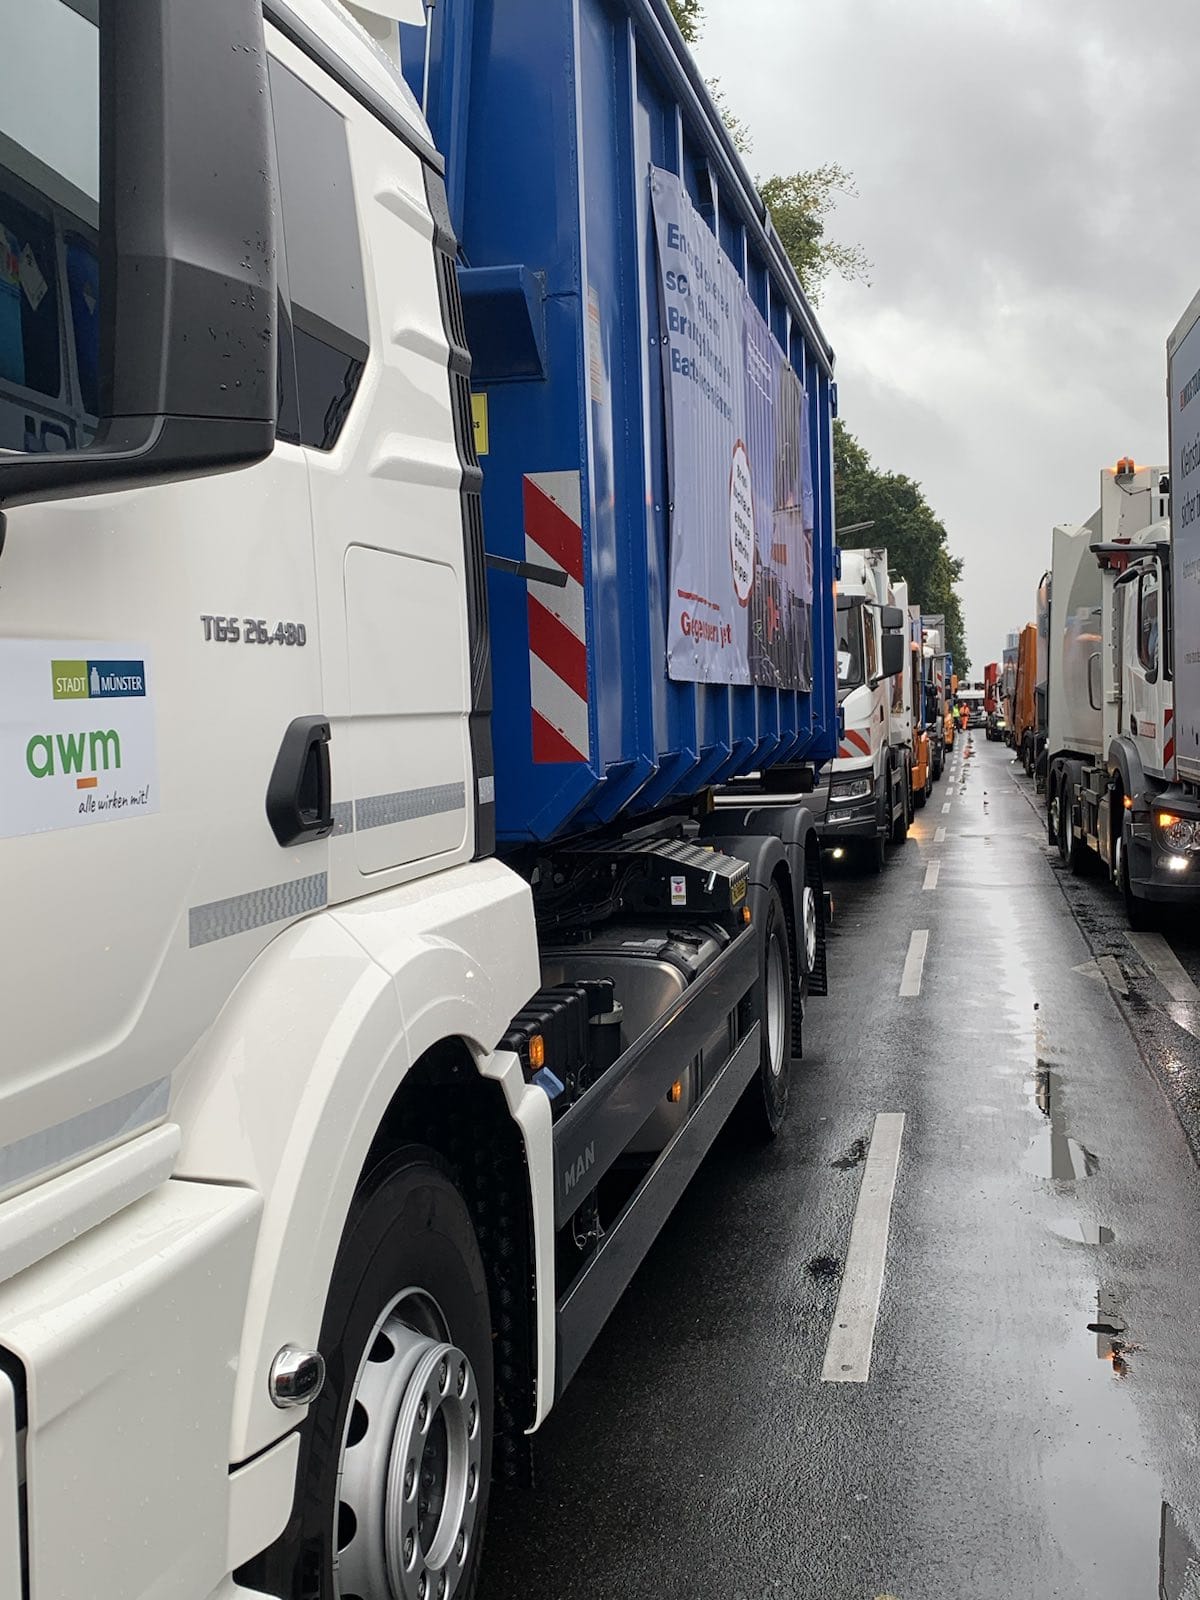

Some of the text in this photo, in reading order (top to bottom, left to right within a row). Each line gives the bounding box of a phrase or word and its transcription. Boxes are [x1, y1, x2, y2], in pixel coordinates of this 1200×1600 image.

[200, 615, 306, 646] TGS 26.480
[56, 673, 143, 692] STADT MÜNSTER
[26, 729, 121, 778] awm
[79, 784, 150, 813] alle wirken mit!
[564, 1140, 595, 1196] MAN
